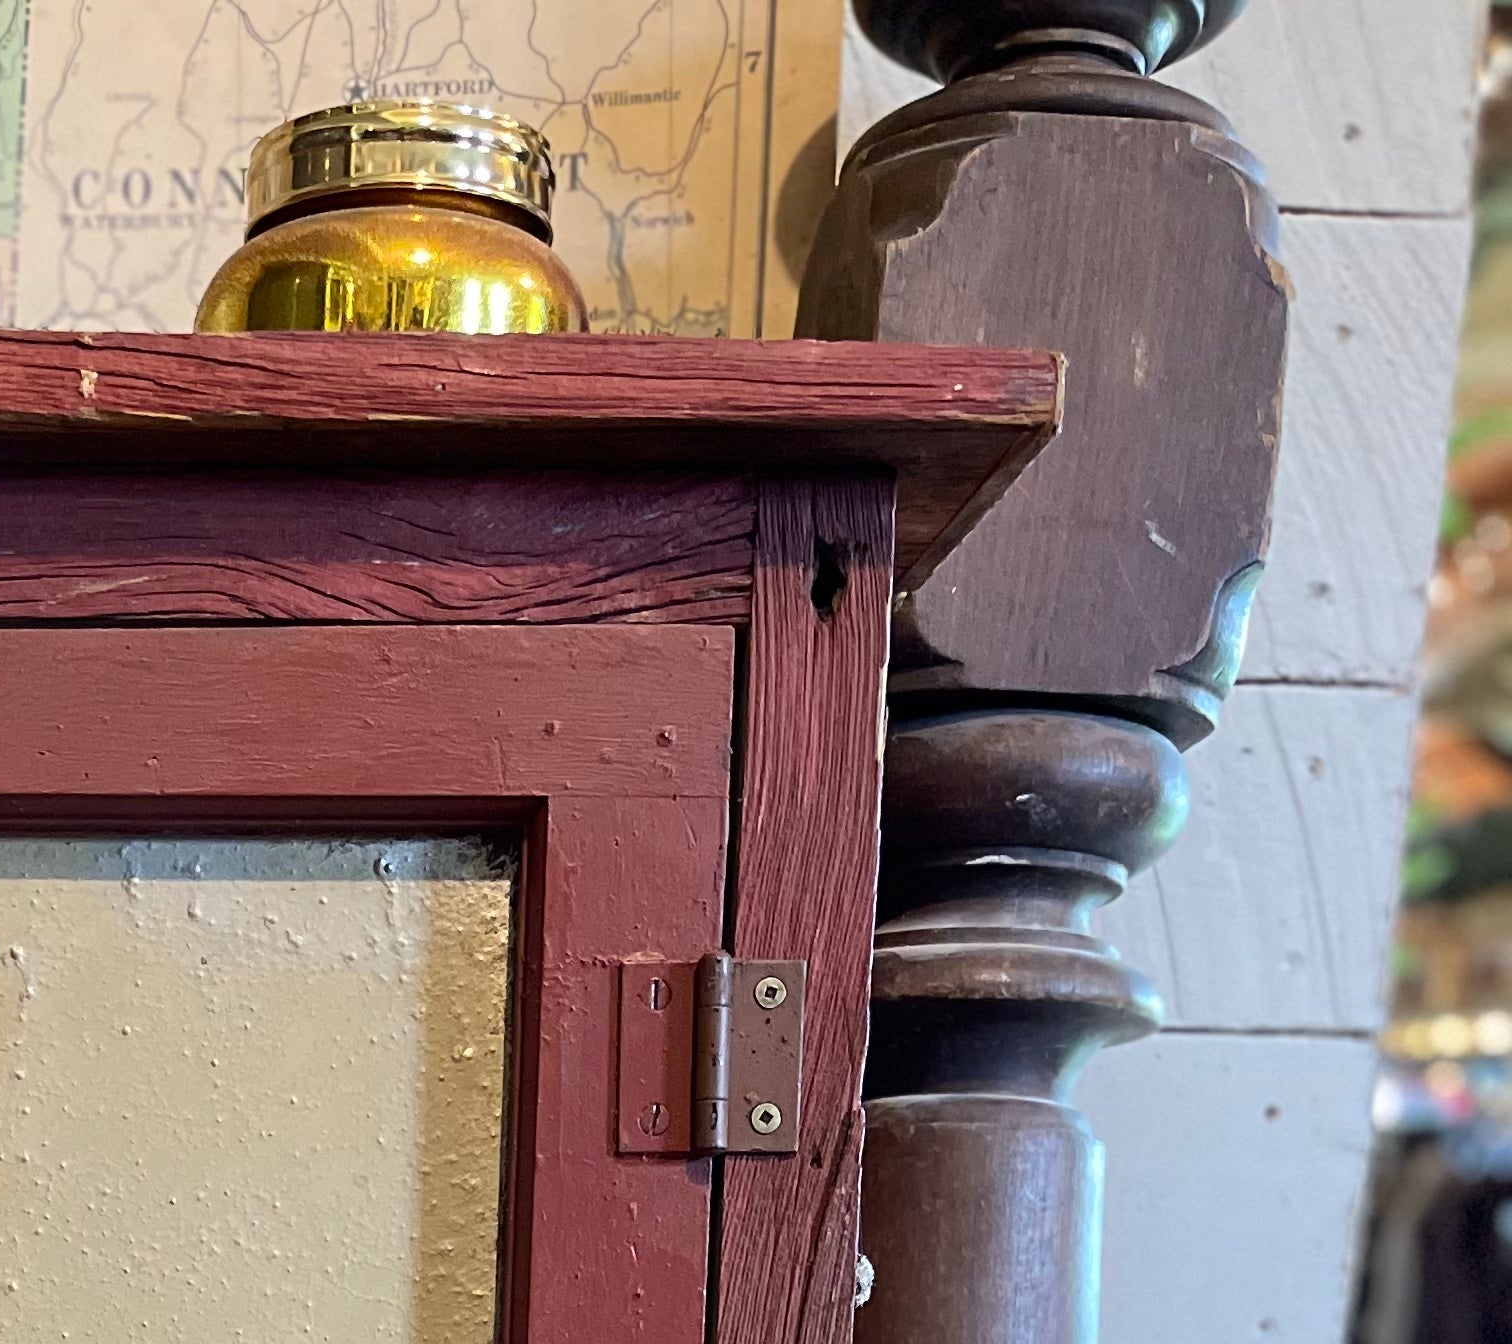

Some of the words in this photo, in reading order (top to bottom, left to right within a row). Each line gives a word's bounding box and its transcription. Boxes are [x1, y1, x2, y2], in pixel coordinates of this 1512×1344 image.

[745, 51, 762, 74] 7
[374, 80, 494, 98] HARTFORD
[591, 89, 681, 107] Willimantic
